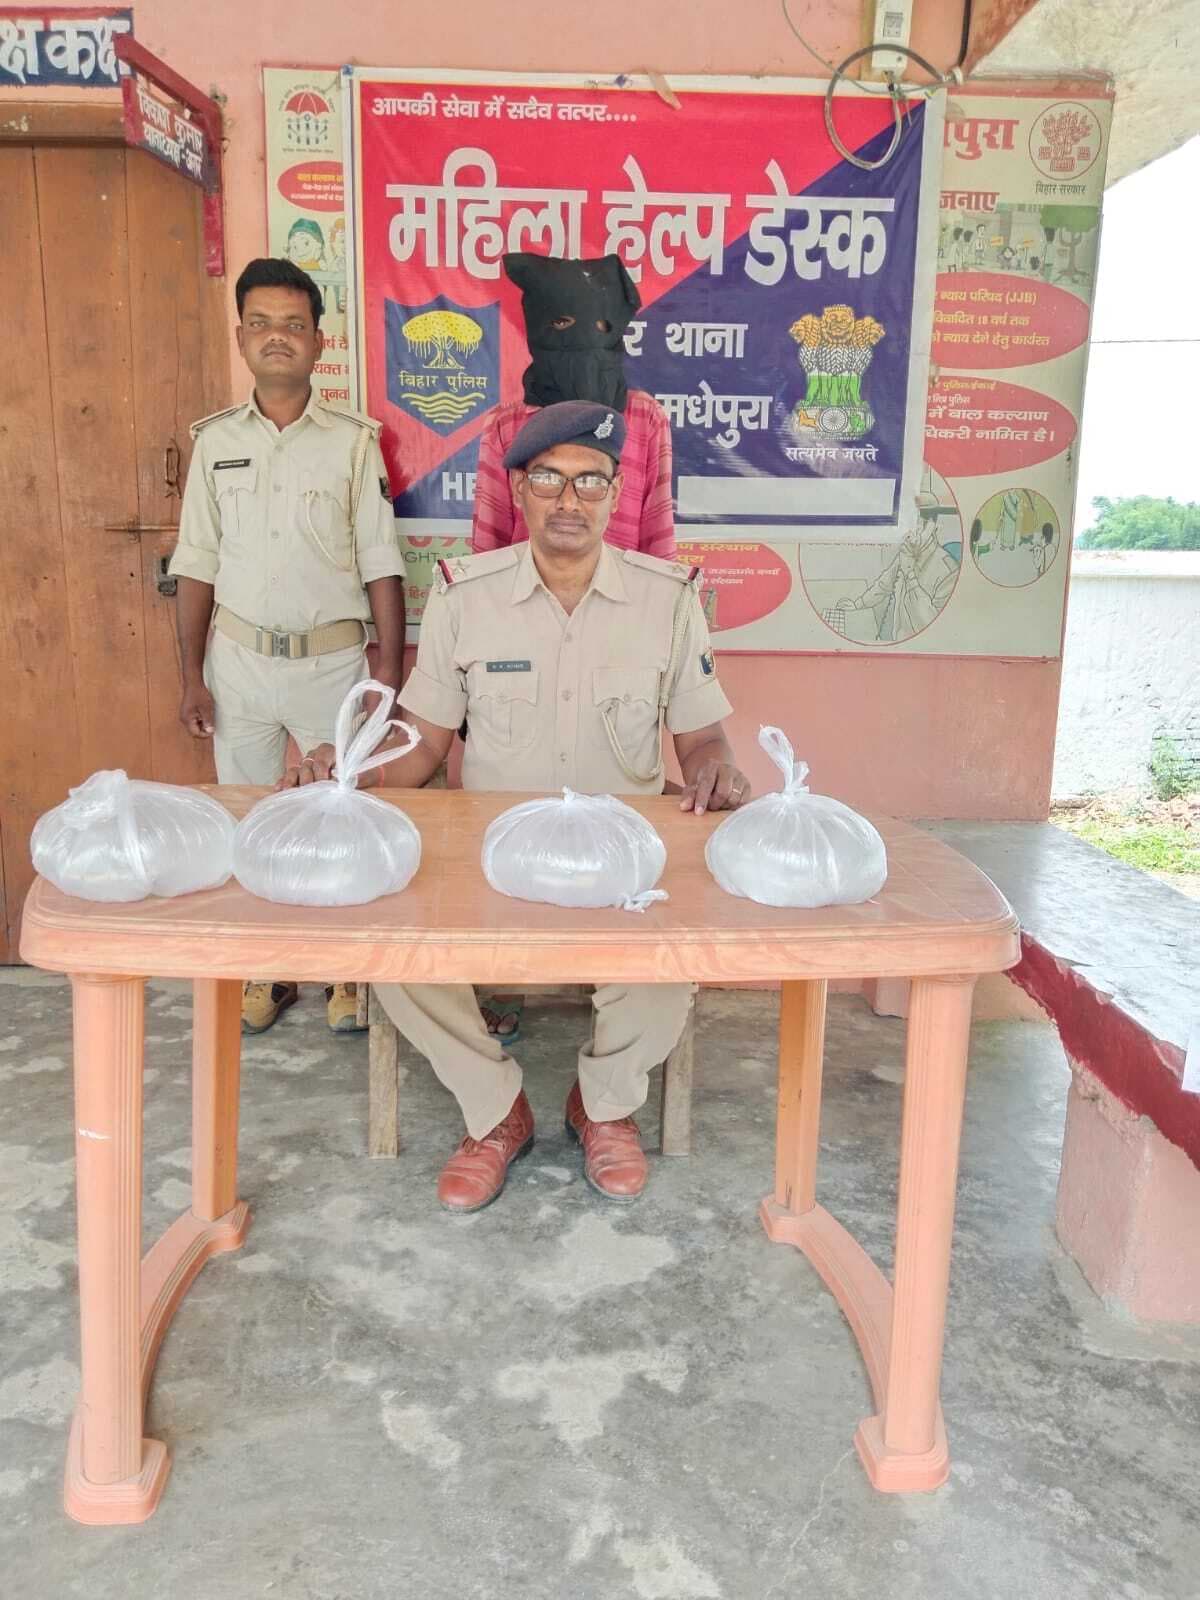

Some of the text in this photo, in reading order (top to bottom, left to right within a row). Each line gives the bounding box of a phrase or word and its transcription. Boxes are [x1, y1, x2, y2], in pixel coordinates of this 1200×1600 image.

[371, 92, 437, 117] आपकी
[442, 94, 480, 118] सेवा
[484, 95, 505, 119] में
[507, 96, 552, 120] सदैव
[1035, 180, 1087, 195] बिहार सरकार
[385, 146, 895, 286] महिला हेल्प डेस्क
[665, 322, 749, 358] थाना
[398, 370, 488, 393] बिहार पुलिस
[655, 380, 773, 449] मधेपुरा
[987, 410, 1050, 421] कल्याण
[785, 442, 879, 461] सत्यमेव जयते
